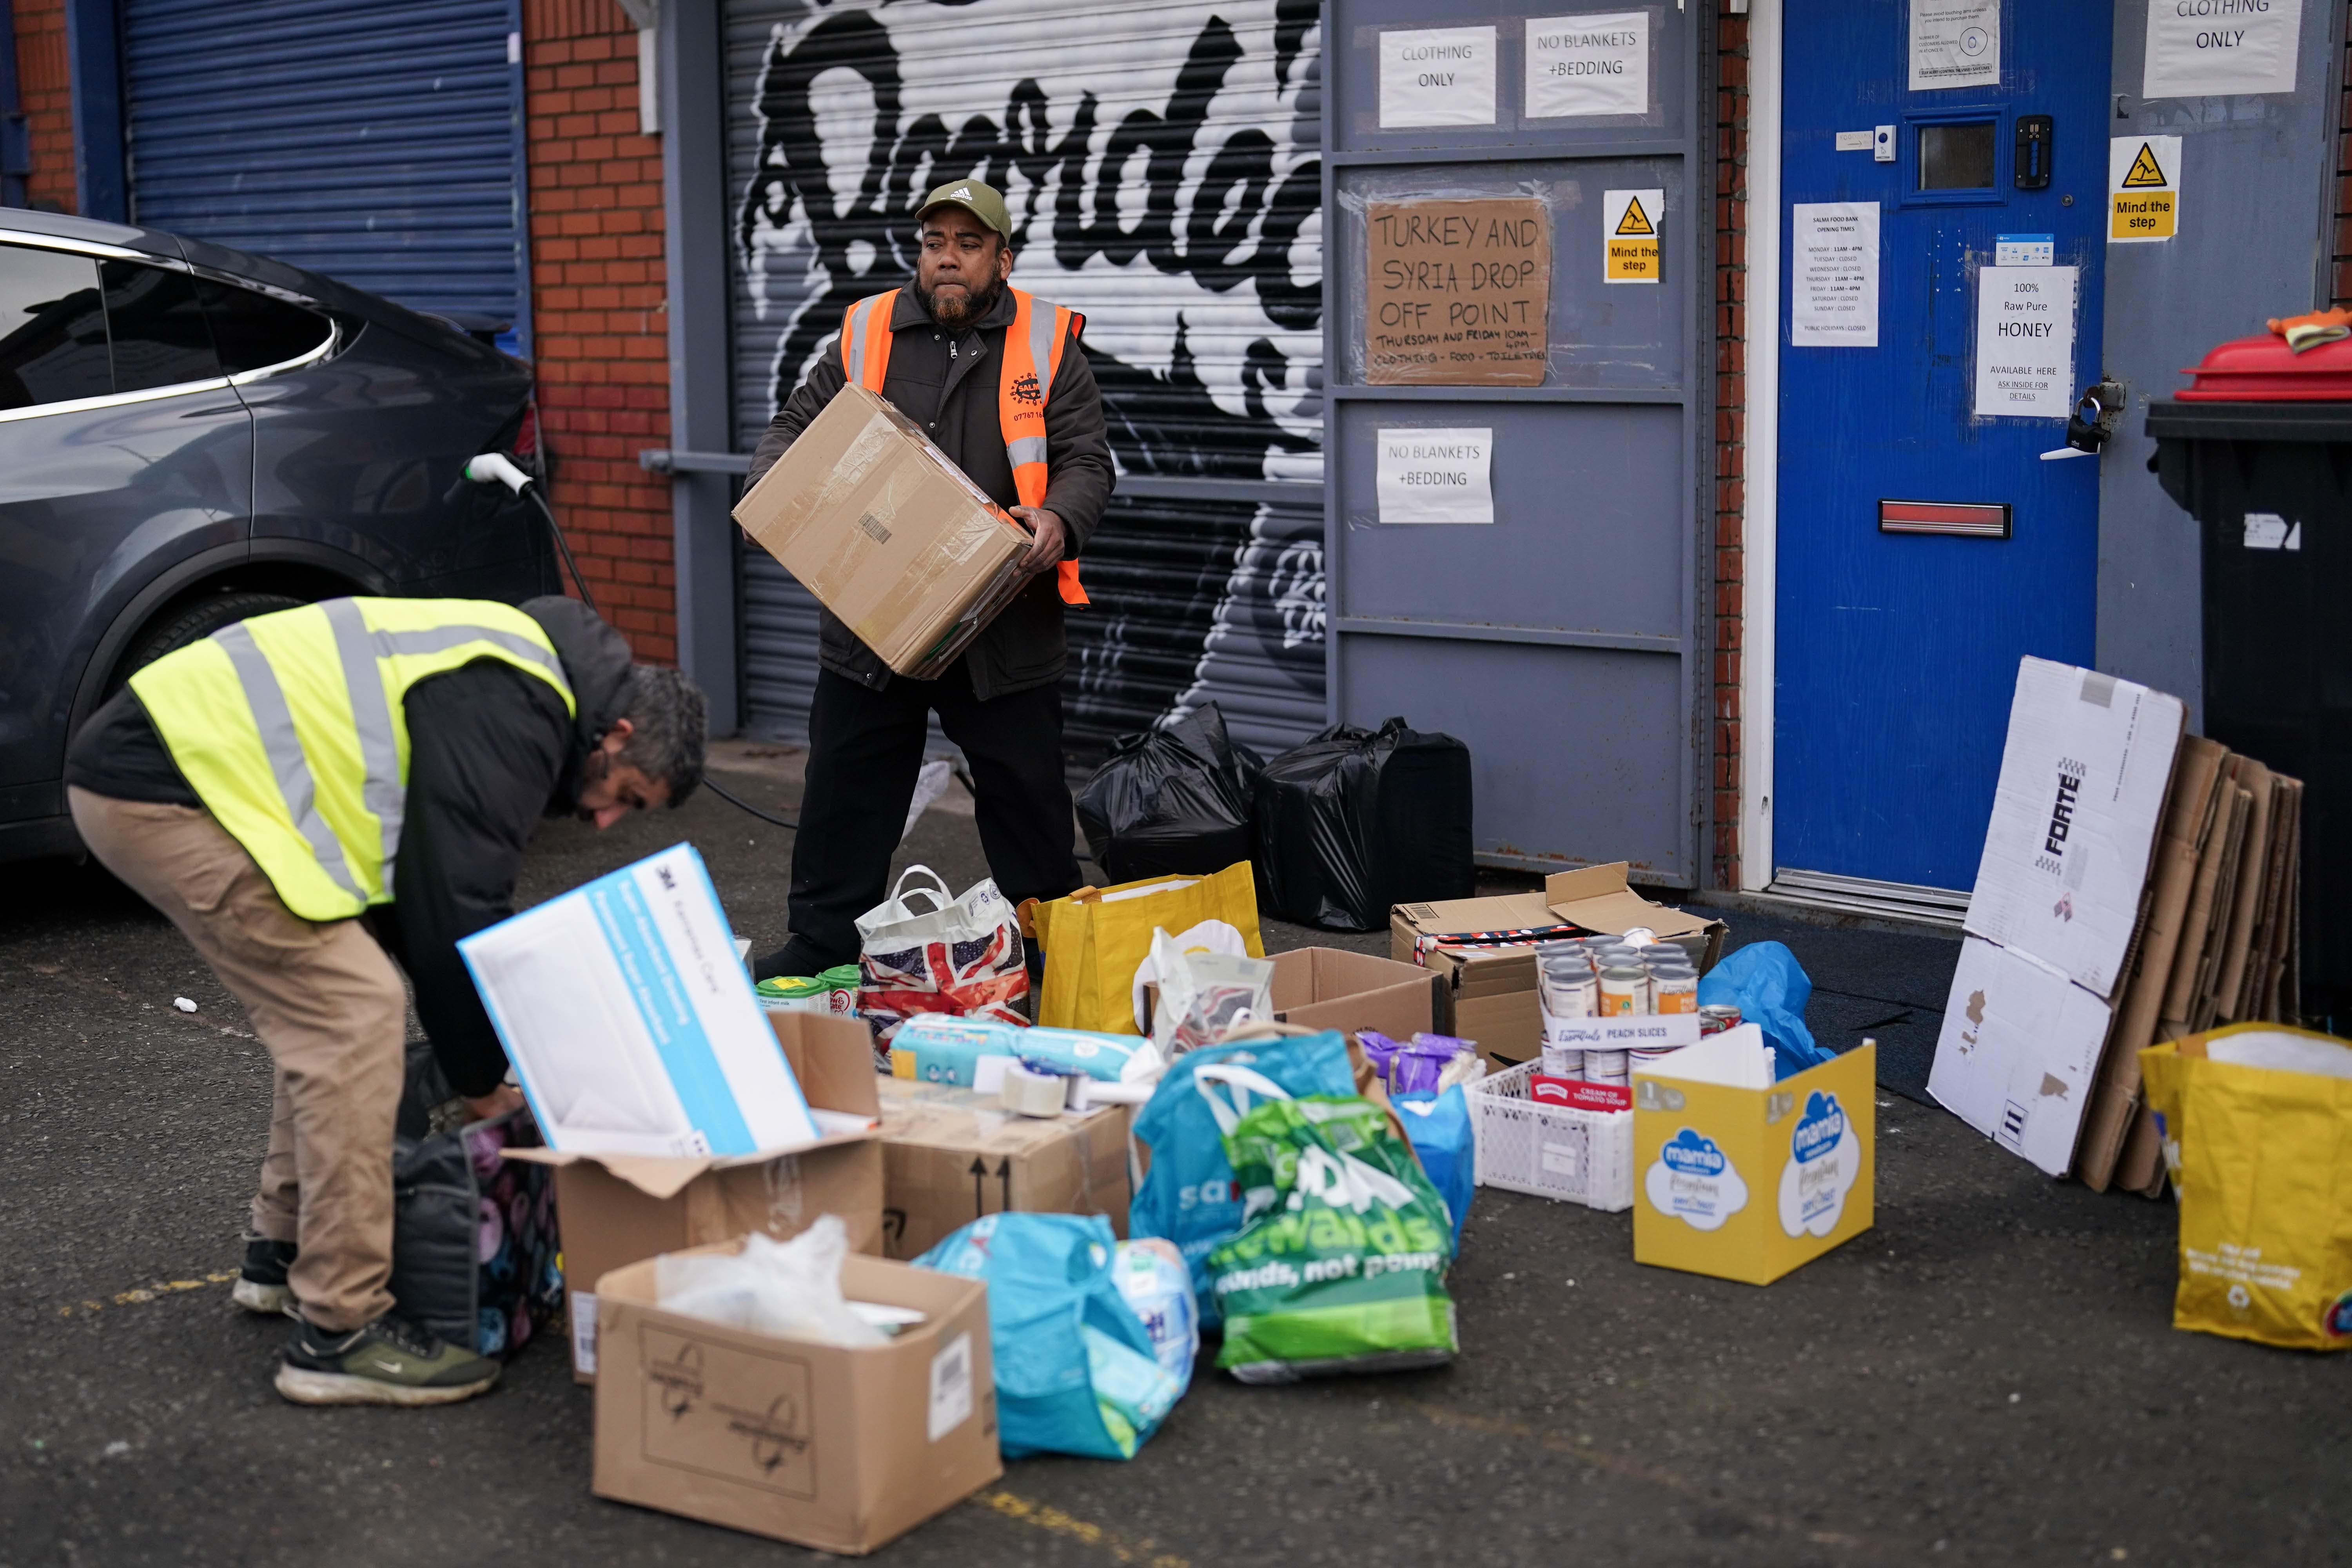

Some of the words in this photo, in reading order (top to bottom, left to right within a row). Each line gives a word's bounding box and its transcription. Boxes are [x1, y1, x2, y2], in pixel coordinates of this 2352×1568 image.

[2177, 0, 2269, 16] CLOTHING
[1537, 35, 1559, 49] NO
[1564, 32, 1636, 47] BLANKETS
[2196, 30, 2245, 48] ONLY
[1402, 45, 1472, 60] CLOTHING
[1549, 60, 1622, 75] +BEDDING
[1419, 73, 1454, 86] ONLY
[2117, 201, 2147, 213] Mind
[2151, 201, 2170, 212] the
[2129, 217, 2156, 230] step
[1375, 214, 1479, 248] TURKEY
[1486, 218, 1538, 248] AND
[1612, 248, 1637, 257] Mind
[1641, 247, 1659, 257] the
[1623, 261, 1646, 272] step
[1383, 260, 1458, 292] SYRIA
[1472, 260, 1534, 292] DROP
[2014, 283, 2039, 292] 100%
[2004, 301, 2024, 310] Raw
[2026, 301, 2047, 311] Pure
[1379, 302, 1431, 328] OFF
[1450, 301, 1529, 327] POINT
[1999, 322, 2053, 337] HONEY
[1376, 333, 1439, 348] THURSDAY
[1443, 331, 1463, 343] AND
[1466, 329, 1500, 340] FRIDAY
[1505, 329, 1529, 339] 10AM
[1449, 352, 1475, 361] FOOD
[1991, 366, 2032, 374] AVAILABLE
[1018, 383, 1040, 392] SALM
[1014, 412, 1034, 421] 07767
[1389, 445, 1408, 459] NO
[1413, 445, 1480, 459] BLANKETS
[1399, 472, 1467, 485] +BEDDING
[1606, 1029, 1635, 1038] PEACH
[1637, 1027, 1667, 1037] SLICES
[1573, 1093, 1605, 1103] TOMATO
[1606, 1097, 1627, 1106] SOUP
[1580, 1088, 1606, 1098] CREAM
[1796, 1103, 1841, 1152] mamia
[1666, 1143, 1722, 1169] mamia
[1304, 1254, 1357, 1282] not
